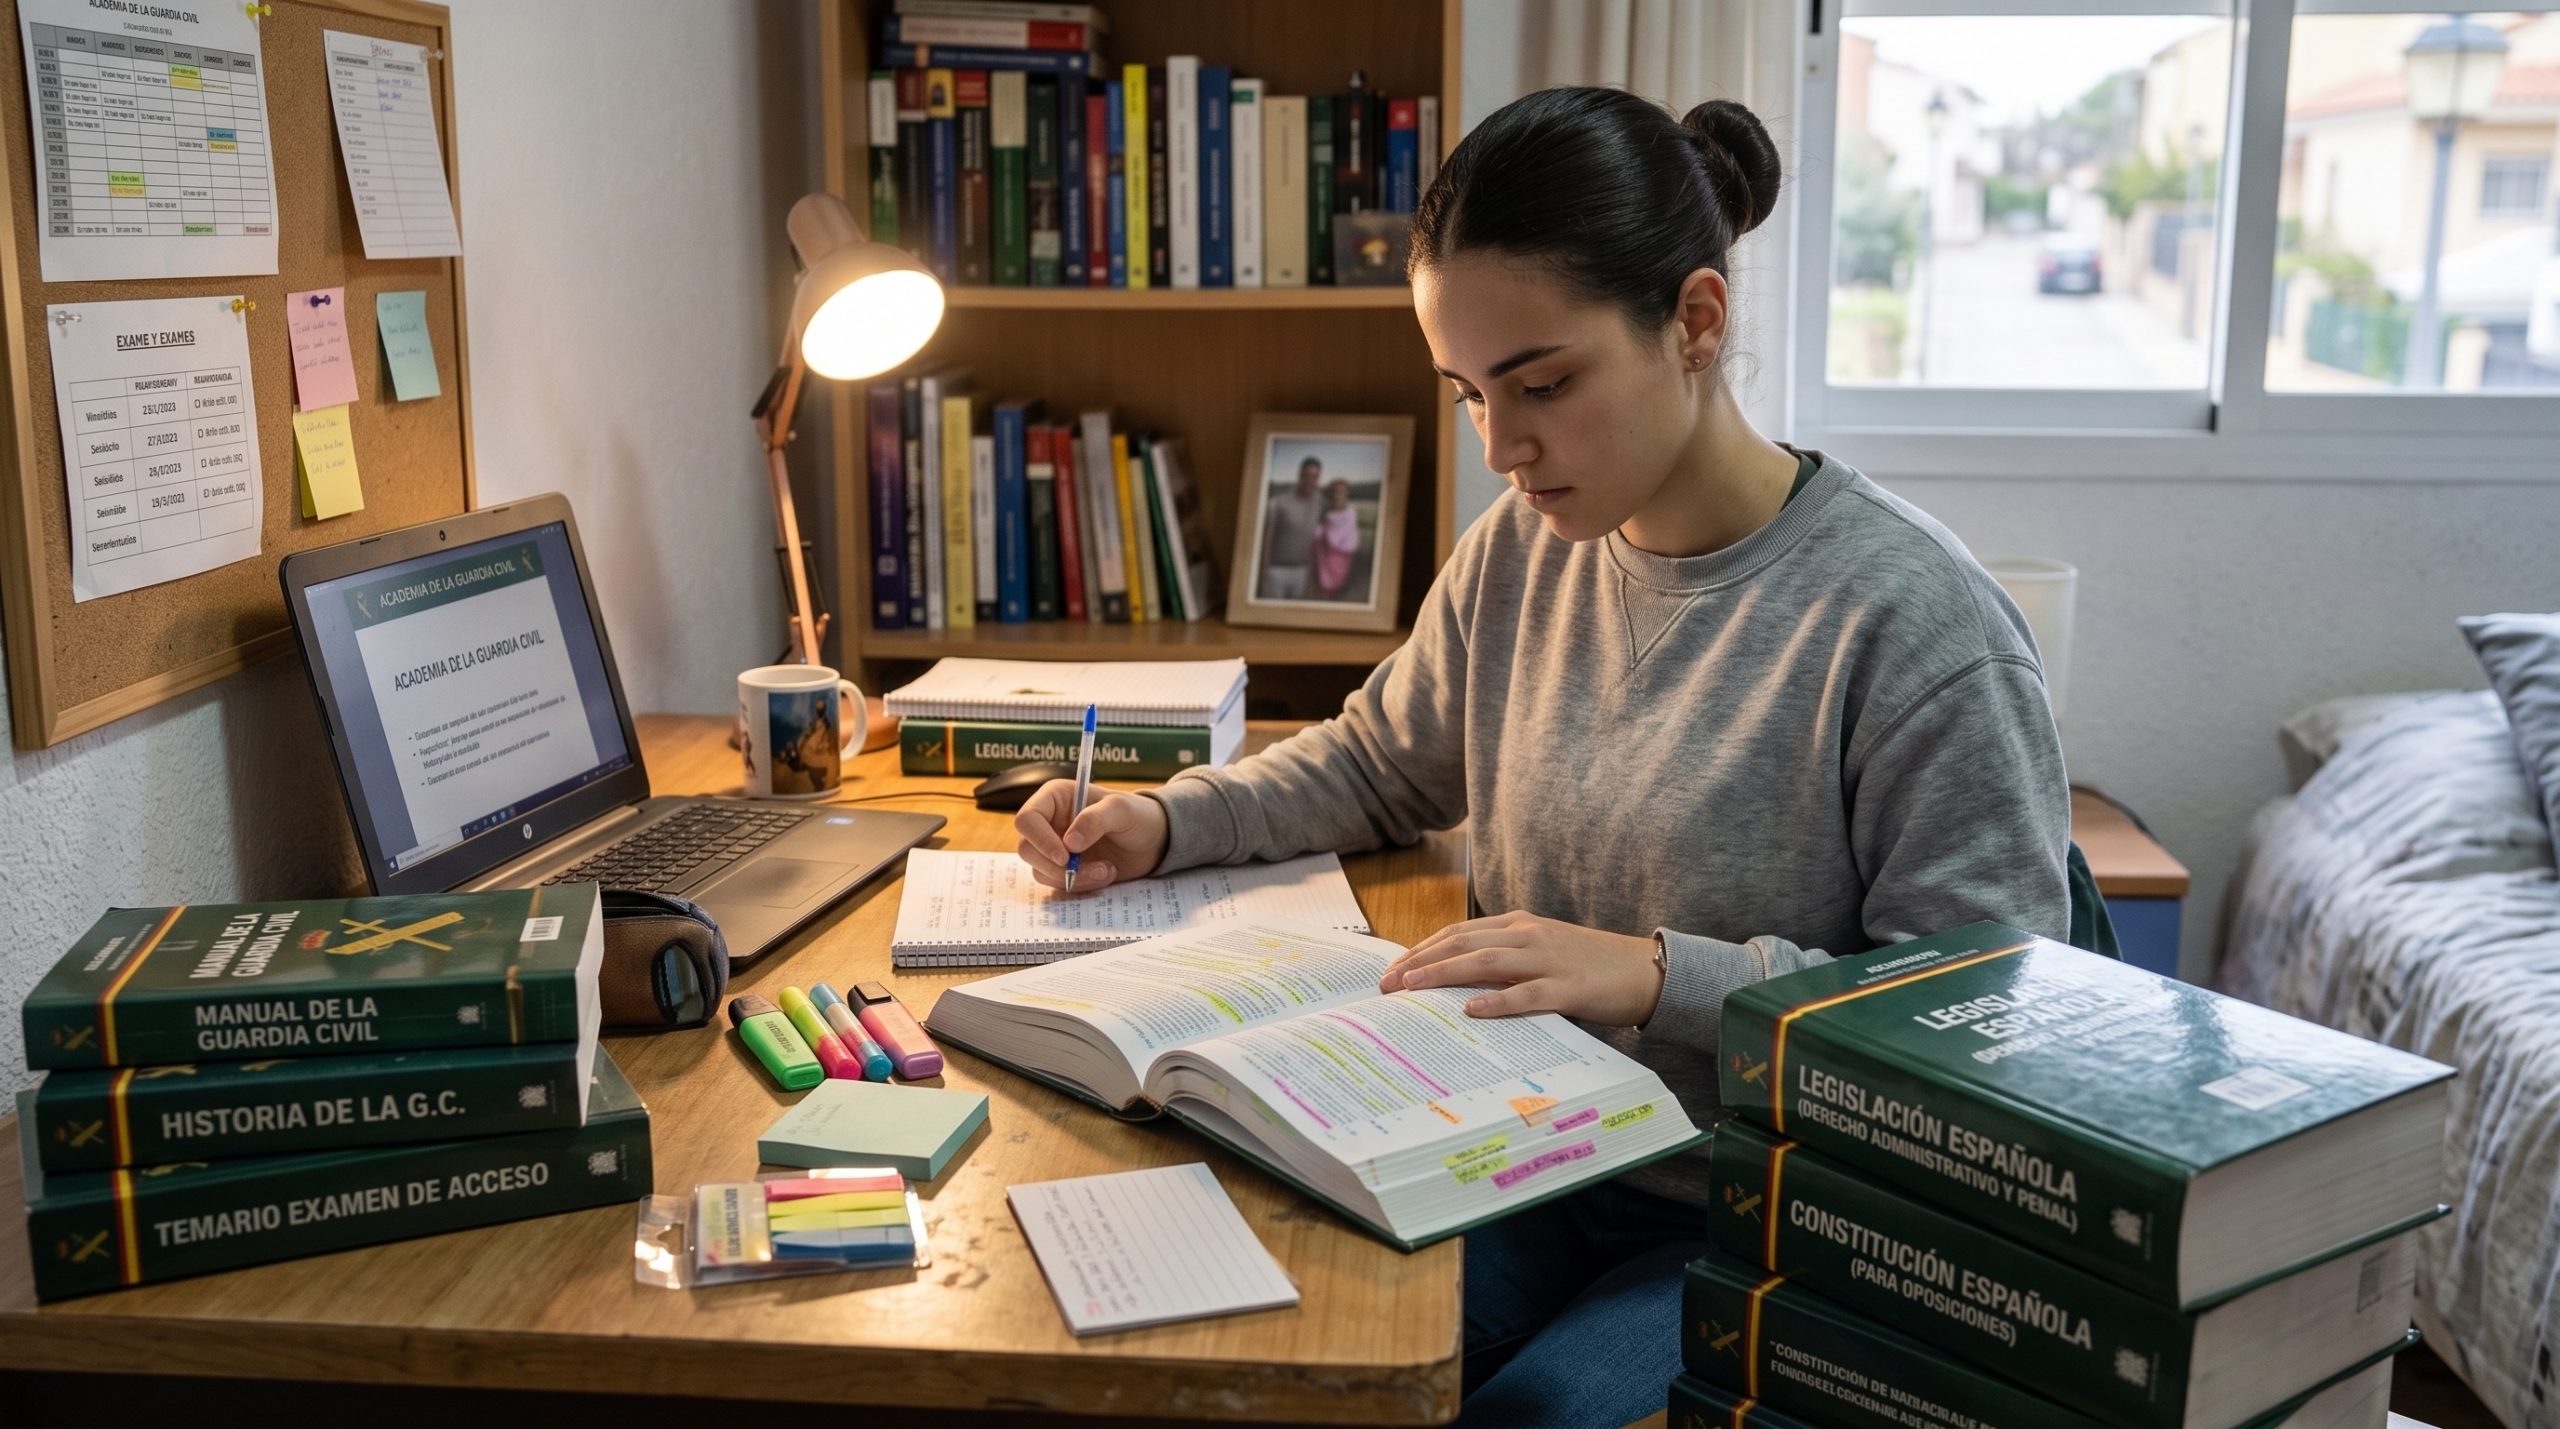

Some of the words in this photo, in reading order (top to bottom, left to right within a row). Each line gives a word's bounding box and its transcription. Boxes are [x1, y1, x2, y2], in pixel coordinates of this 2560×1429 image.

[129, 3, 139, 14] DE
[140, 5, 149, 16] LA
[150, 7, 182, 21] GUARDIA
[182, 11, 199, 24] CIVIL
[117, 334, 149, 348] EXAME
[151, 333, 157, 345] Y
[160, 330, 195, 344] EXAMES
[379, 583, 428, 608] ACADEMIA
[429, 579, 443, 594] DE
[443, 576, 455, 590] LA
[455, 565, 495, 587] GUARDIA
[495, 560, 516, 575] CIVIL
[394, 660, 448, 691] ACADEMIA
[448, 655, 463, 673] DE
[462, 651, 475, 668] LA
[476, 636, 520, 664] GUARDIA
[519, 629, 544, 649] CIVIL
[975, 742, 1064, 761] LEGISLACIÓN
[1069, 744, 1140, 763] EAÑOLA
[221, 925, 255, 937] DE
[229, 912, 263, 925] LA
[189, 937, 246, 978] MANUAL
[231, 933, 286, 977] GUARDIA
[261, 910, 300, 933] CIVIL
[195, 1001, 303, 1026] MANUAL
[309, 999, 342, 1020] DE
[347, 997, 379, 1018] LA
[197, 1025, 310, 1051] GUARDIA
[315, 1021, 379, 1043] CIVIL
[162, 1100, 307, 1140] HISTORIA
[315, 1098, 354, 1126] DE
[362, 1095, 400, 1122] LA
[407, 1090, 466, 1118] G.C.
[1799, 1064, 1942, 1146] LEGISLACIÓN
[1949, 1123, 2078, 1202] ESPAÑOLA
[1798, 1098, 1868, 1141] (DERECHO
[1870, 1128, 1999, 1197] ADMINISTRATIVO
[2002, 1182, 2014, 1202] Y
[2017, 1188, 2079, 1235] PENAL)
[154, 1203, 281, 1247] TEMARIO
[288, 1187, 400, 1226] EXAMEN
[407, 1179, 441, 1206] DE
[447, 1162, 549, 1200] ACCESO
[1790, 1200, 1955, 1290] CONSTITUCIÓN
[1961, 1270, 2093, 1350] ESPAÑOLA
[1850, 1256, 1898, 1293] (PARA
[1902, 1278, 2017, 1347] OPOSICIONES)
[1871, 1380, 1888, 1397] DE
